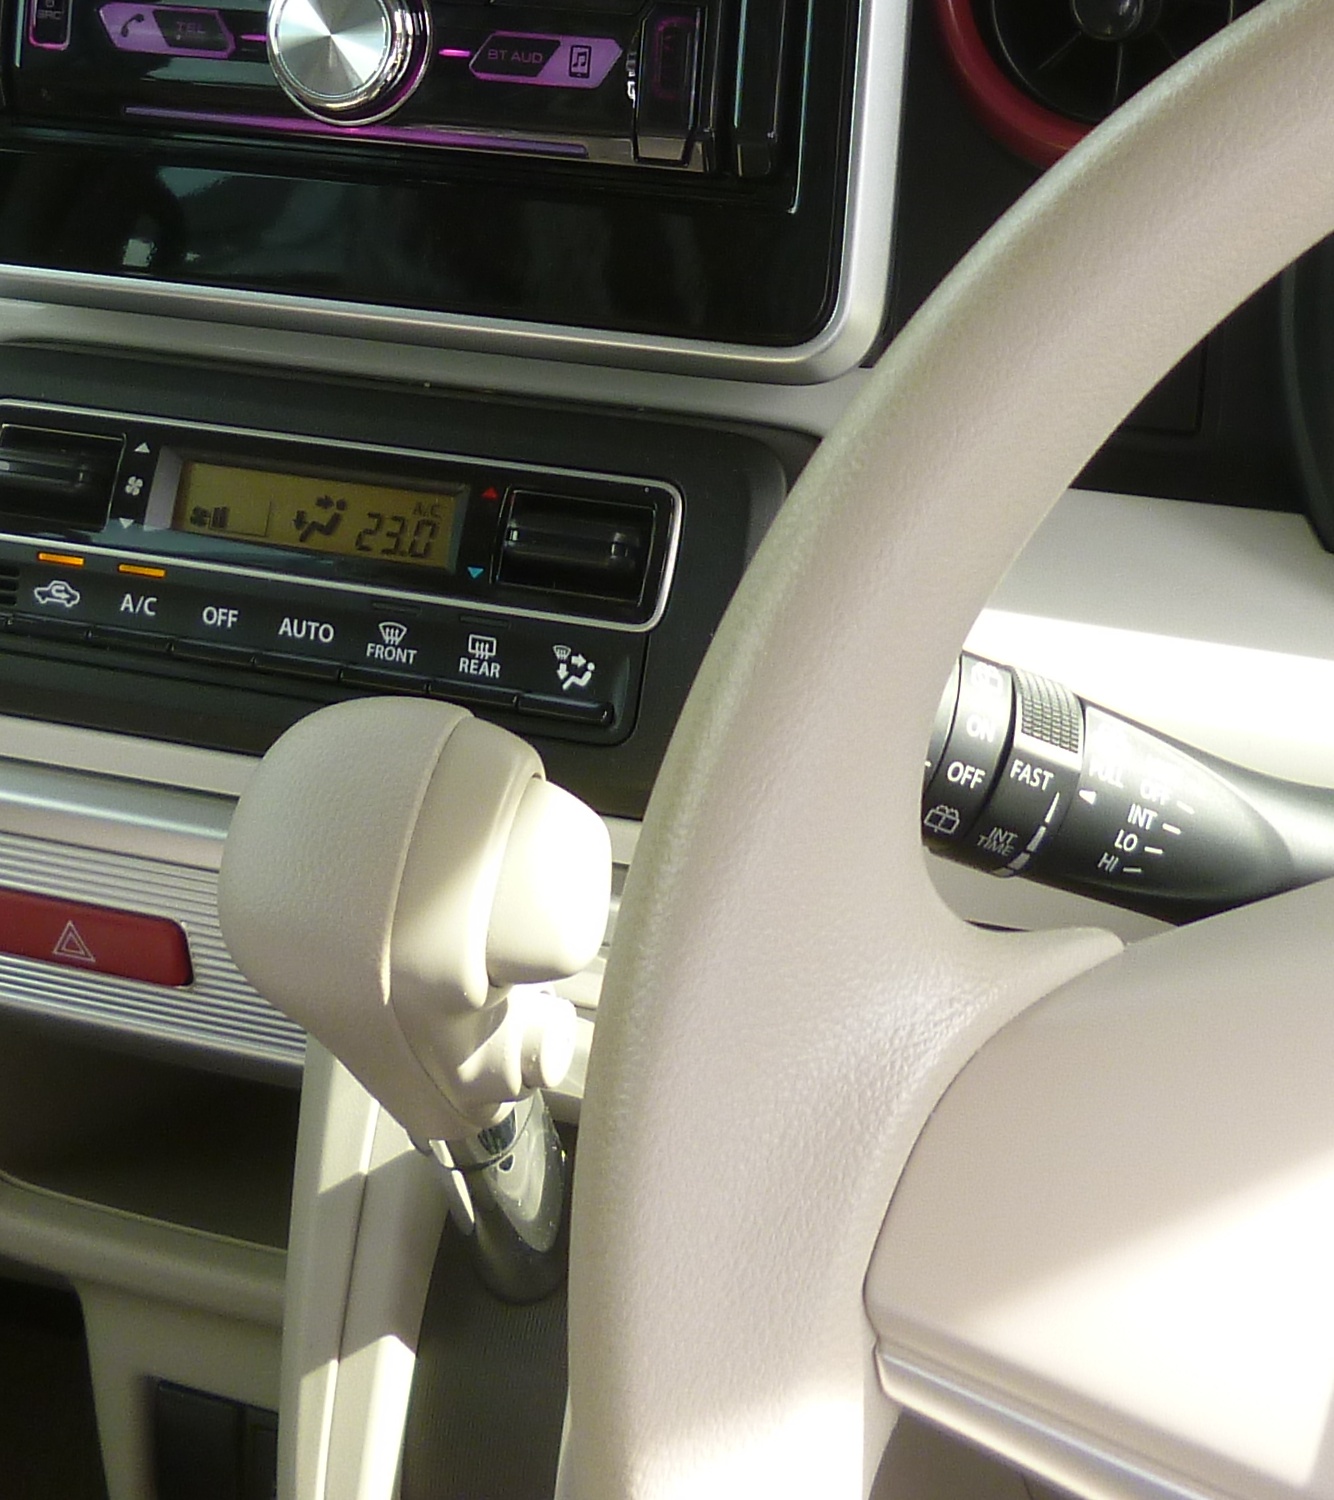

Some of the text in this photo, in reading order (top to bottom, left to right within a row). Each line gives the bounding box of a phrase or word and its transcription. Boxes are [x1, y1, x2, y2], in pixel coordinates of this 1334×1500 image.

[487, 48, 544, 64] BT AUD
[412, 501, 442, 518] A/C
[355, 511, 441, 558] 23.0
[119, 593, 158, 618] A/C
[201, 606, 239, 630] OFF
[277, 616, 336, 644] AUTO
[365, 643, 418, 667] FRONT
[458, 656, 502, 679] REAR
[966, 714, 997, 743] ON
[946, 759, 987, 791] OFF
[1009, 759, 1055, 791] FAST
[1139, 778, 1172, 806] OFF
[1127, 802, 1159, 830] INT
[976, 835, 1016, 858] TIME
[987, 826, 1019, 846] INT
[1113, 829, 1139, 854] LO
[1097, 853, 1121, 873] HI
